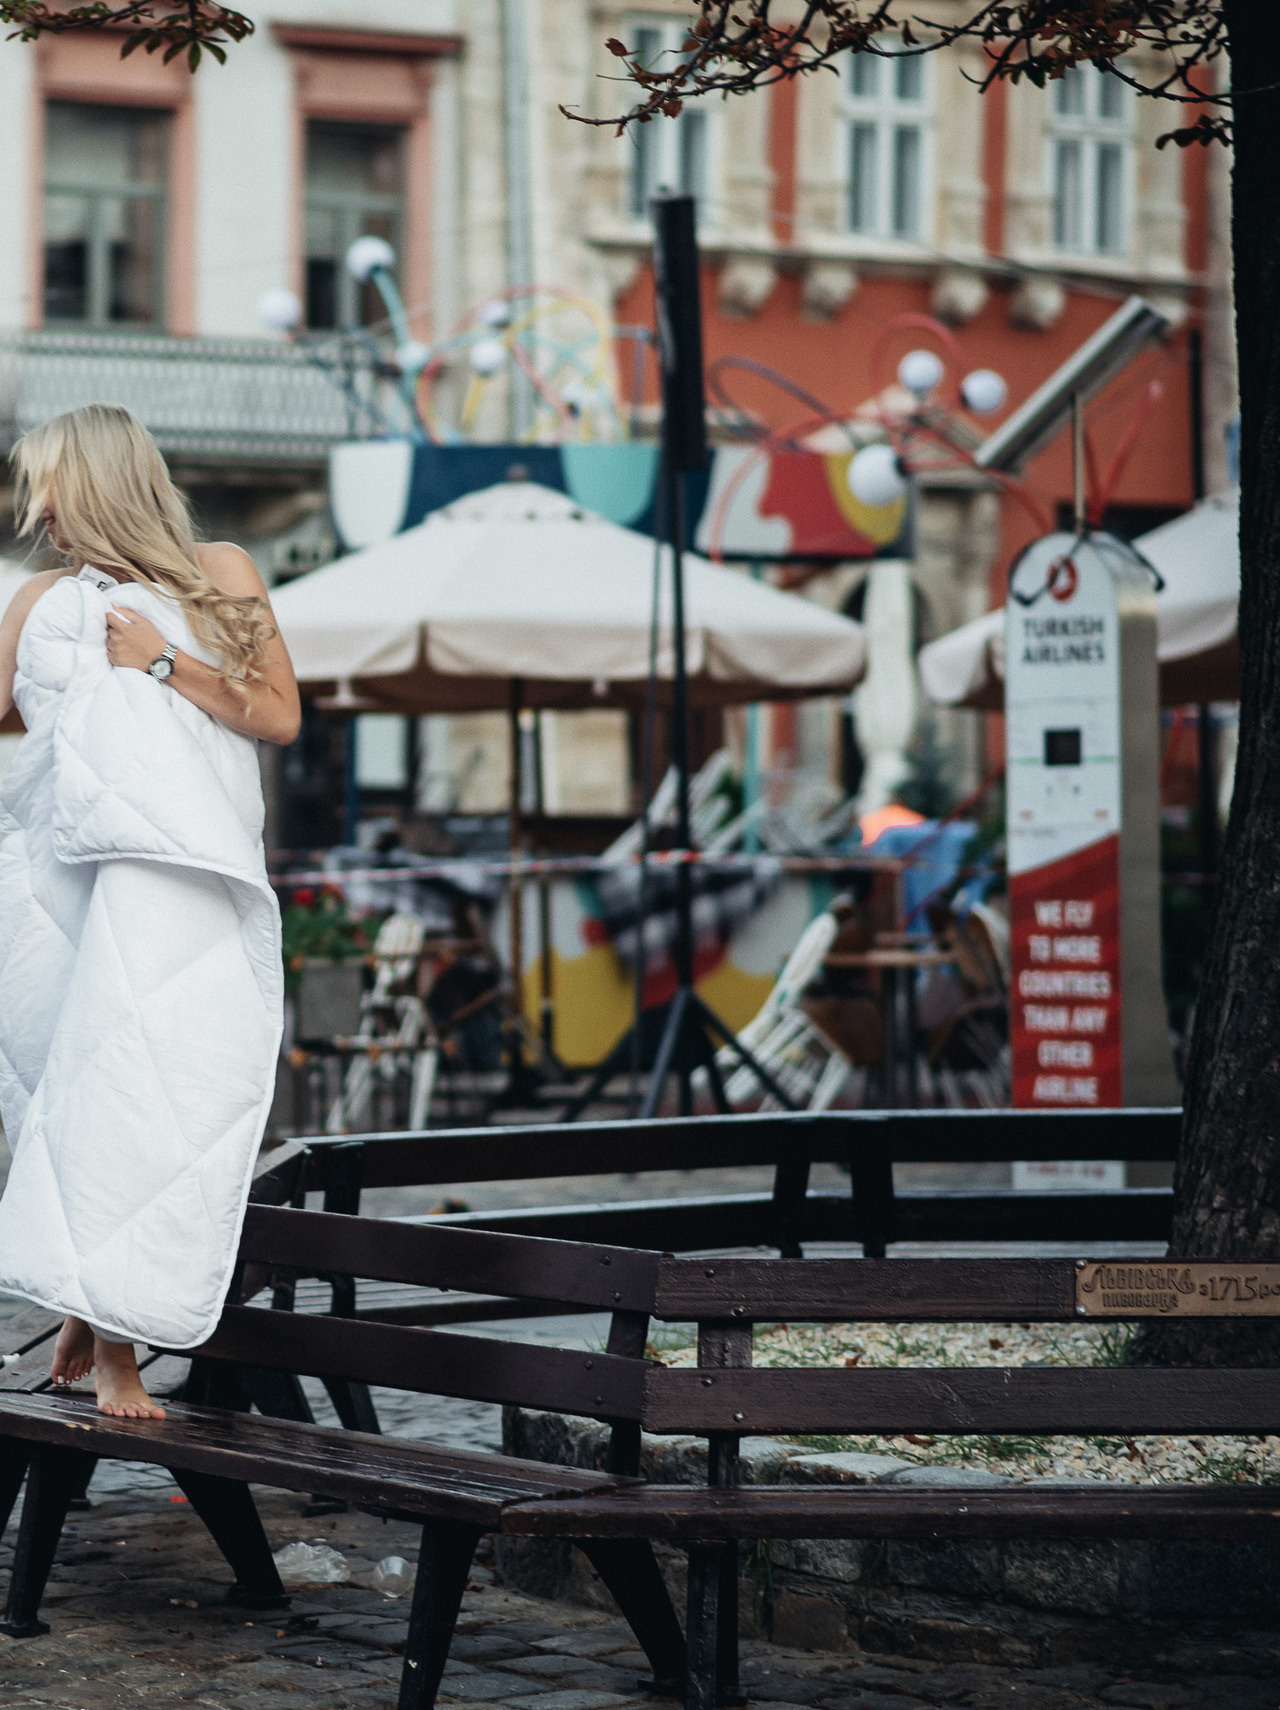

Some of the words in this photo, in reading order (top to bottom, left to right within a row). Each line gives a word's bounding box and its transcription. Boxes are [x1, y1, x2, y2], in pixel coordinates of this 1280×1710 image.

[1023, 617, 1104, 638] TURKISH
[1023, 644, 1105, 665] AIRLINES
[1035, 901, 1062, 928] WE
[1065, 901, 1094, 928] FLY
[1029, 935, 1051, 963] TO
[1053, 935, 1101, 963] MORE
[1019, 971, 1111, 999] COUNTRIES
[1024, 1005, 1068, 1031] THAN
[1071, 1006, 1107, 1032] ANY
[1038, 1041, 1093, 1068] OTHER
[1034, 1076, 1098, 1104] AIRLINE
[1208, 1275, 1259, 1302] 1715
